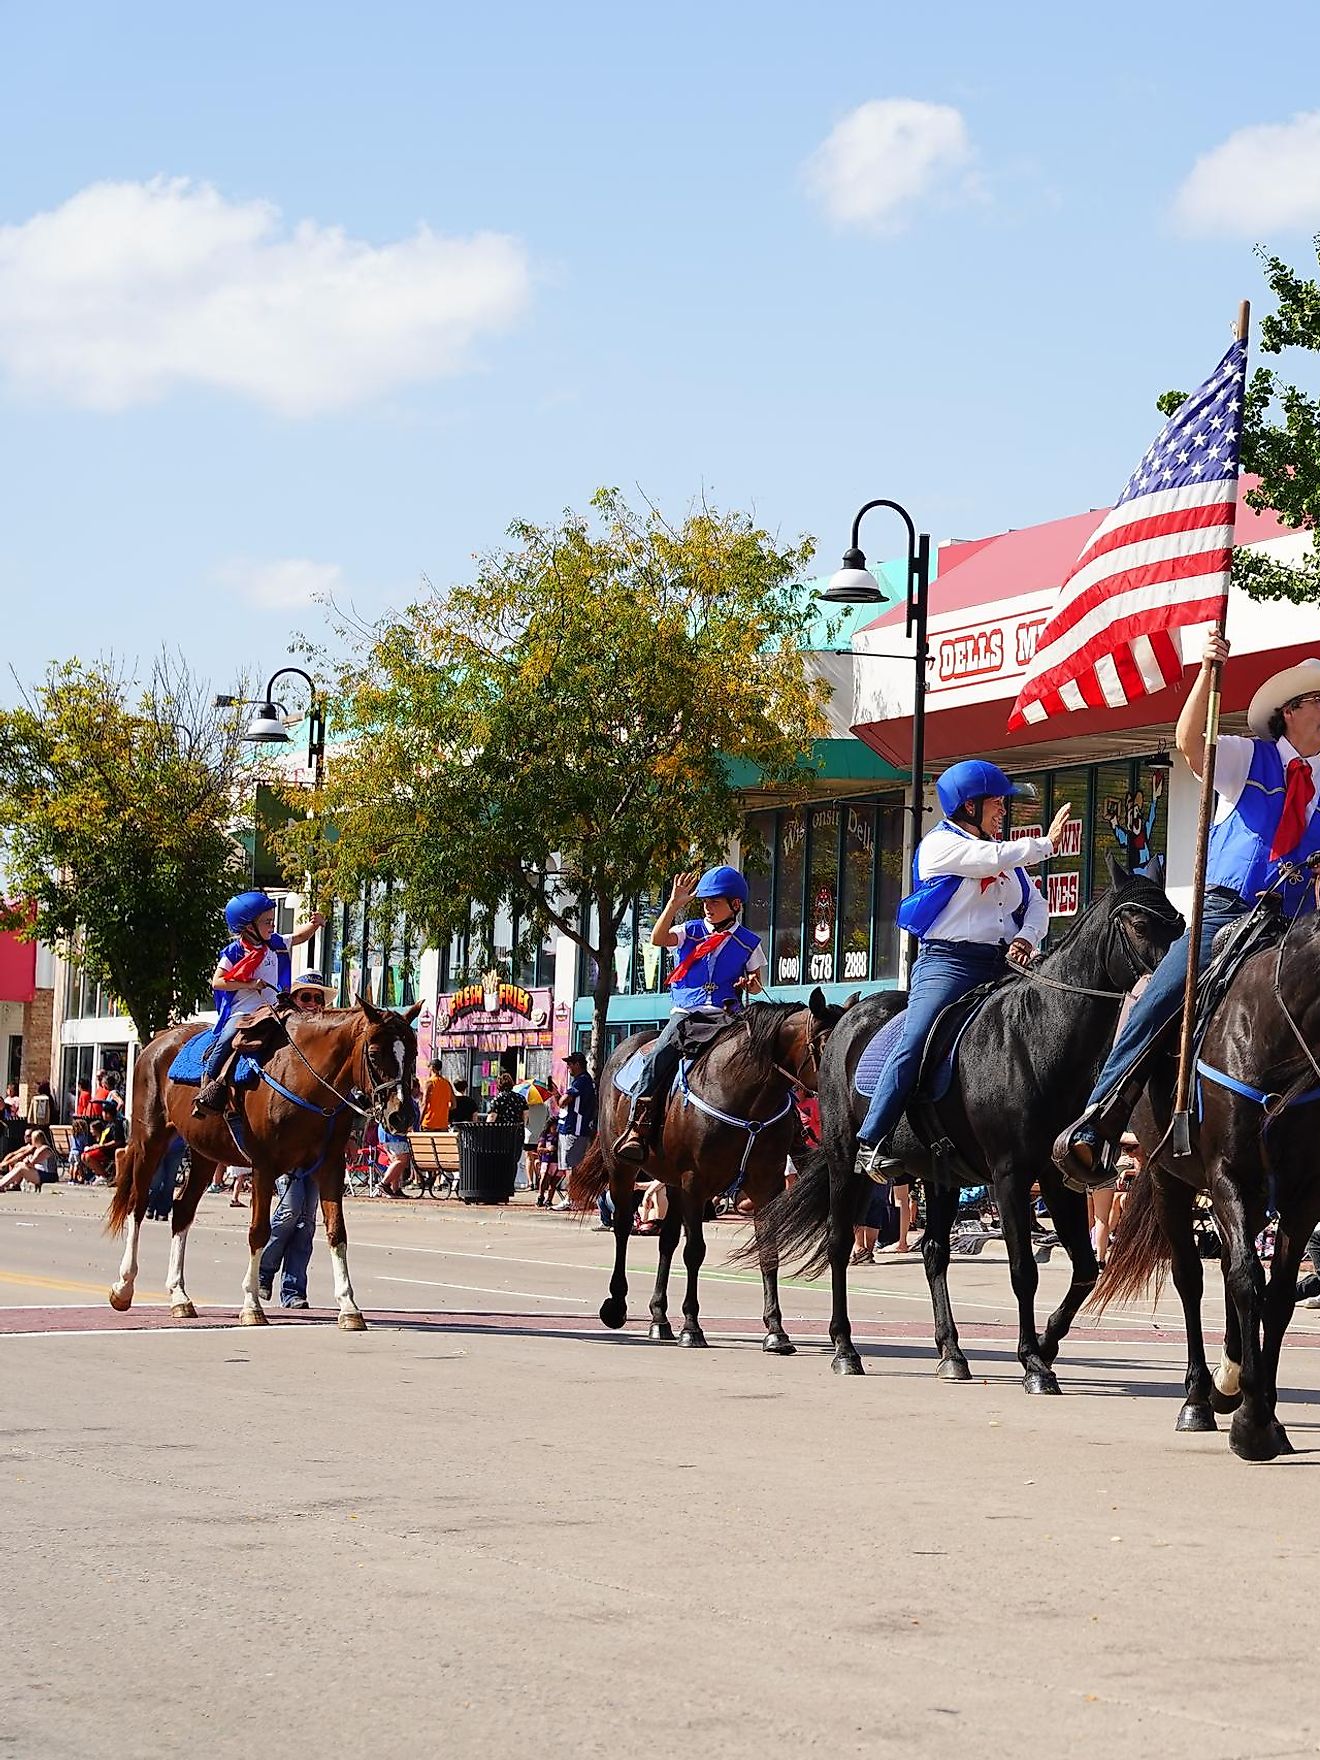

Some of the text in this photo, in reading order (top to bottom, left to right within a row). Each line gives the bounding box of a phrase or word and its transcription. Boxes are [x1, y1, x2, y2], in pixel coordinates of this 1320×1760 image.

[940, 629, 1003, 681] DELLS
[778, 951, 867, 981] (608) 678 2888
[450, 982, 530, 1016] FRESH FRIES
